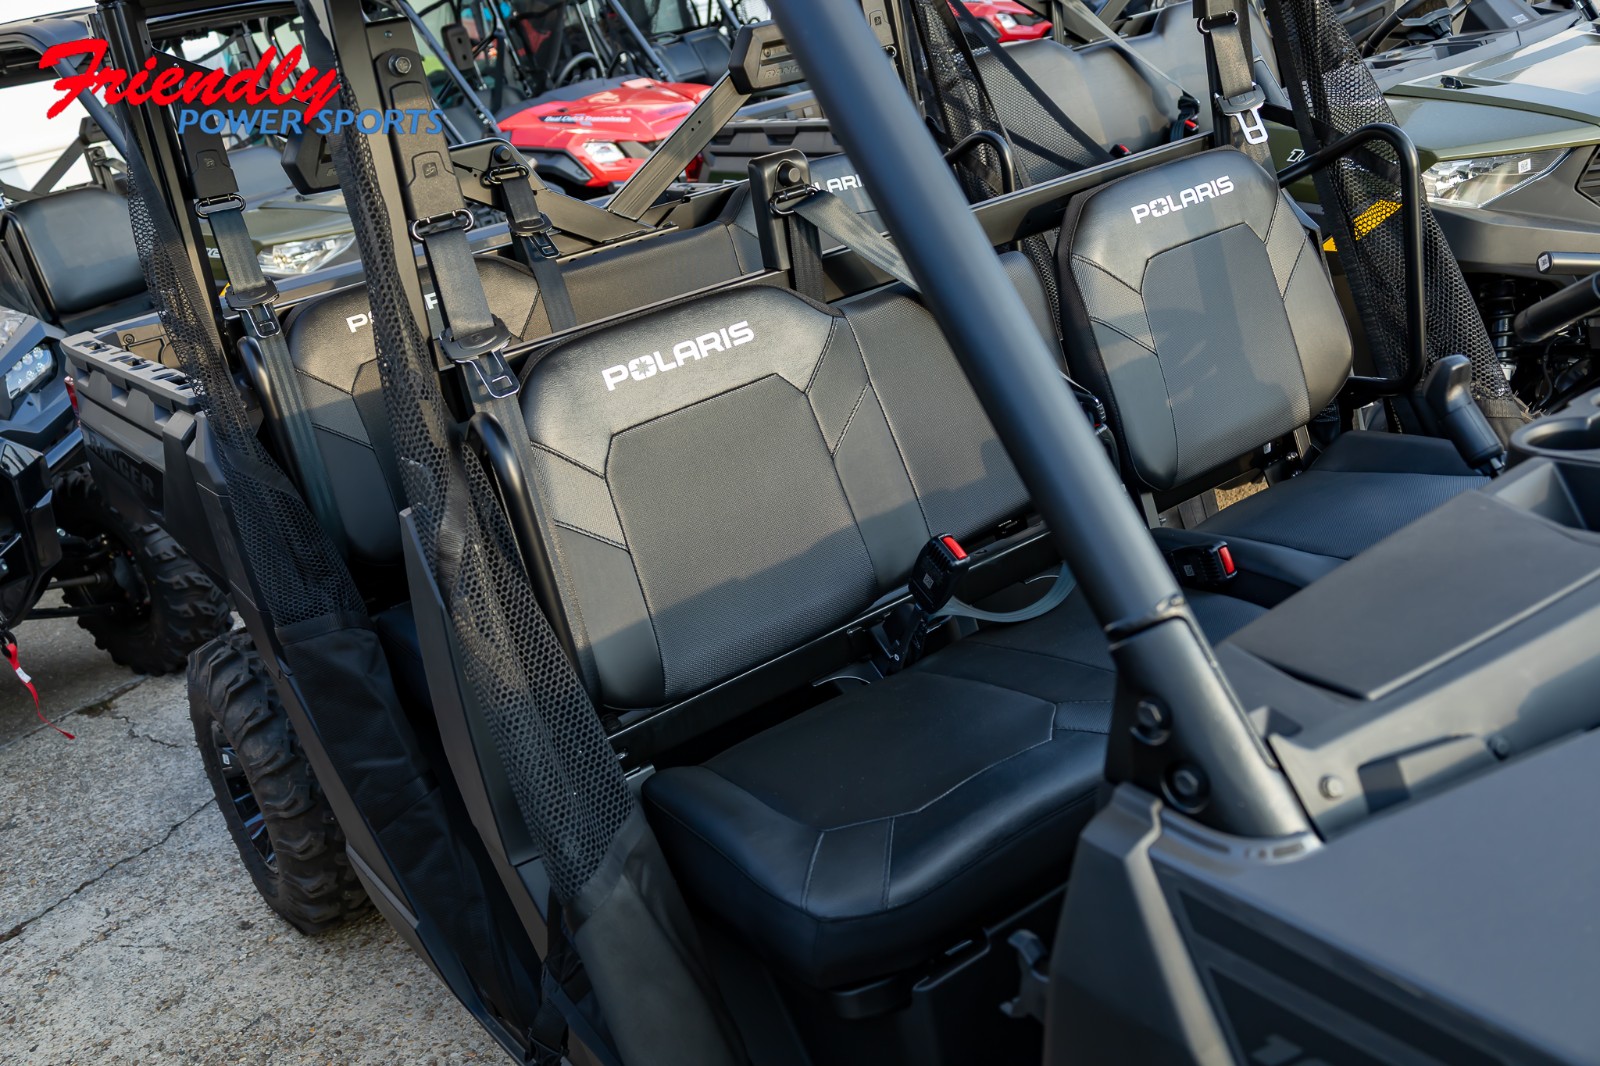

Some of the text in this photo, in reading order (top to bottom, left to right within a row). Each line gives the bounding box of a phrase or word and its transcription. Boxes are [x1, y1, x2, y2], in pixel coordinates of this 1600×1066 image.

[1130, 175, 1235, 224] POLARIS
[601, 320, 755, 392] POLARIS
[88, 431, 155, 498] RANGER
